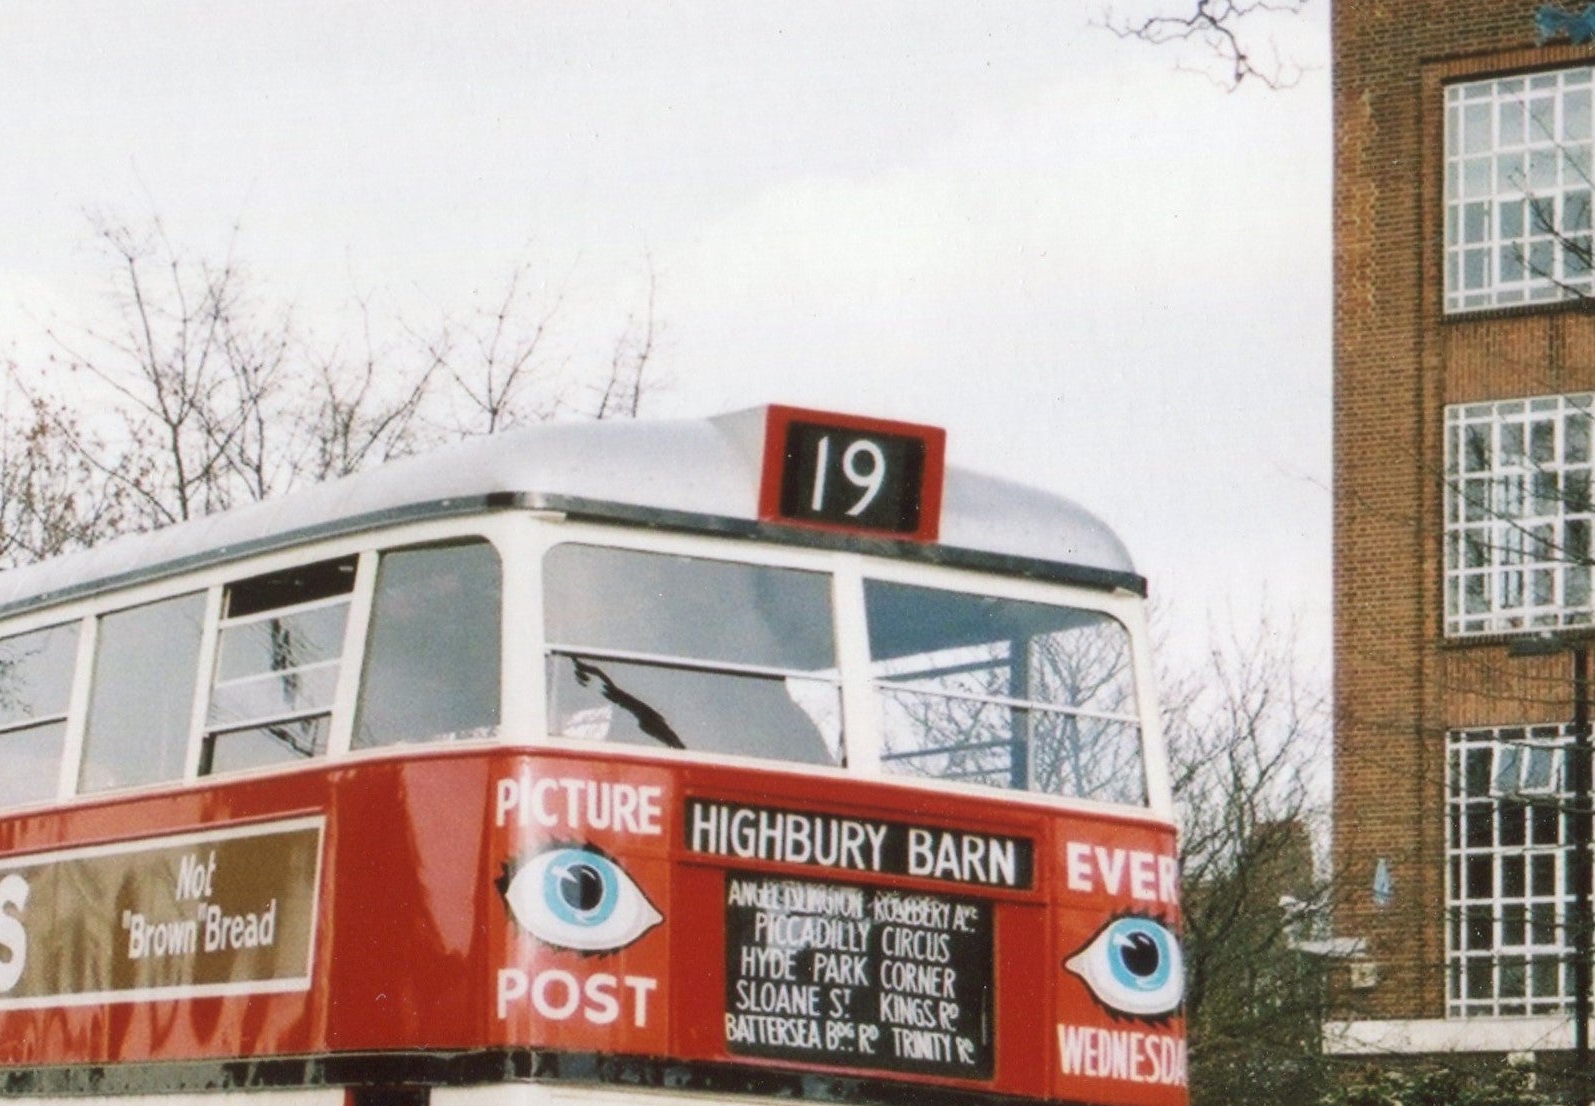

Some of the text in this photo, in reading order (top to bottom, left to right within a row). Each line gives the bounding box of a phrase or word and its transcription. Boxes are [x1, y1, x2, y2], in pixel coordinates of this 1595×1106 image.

[811, 436, 885, 516] 19
[496, 776, 663, 836] PICTURE
[691, 802, 1017, 887] HIGHBURY BARN
[176, 852, 217, 900] Not
[1066, 841, 1180, 906] EVER
[203, 901, 276, 952] Bread
[755, 912, 951, 964] PICCADILLY CIRCUS
[497, 968, 658, 1028] POST
[741, 945, 957, 1000] HYDE PARK CORNER
[736, 980, 821, 1018] SLOANE
[879, 993, 936, 1028] KINGS
[725, 1012, 822, 1050] BATTERSEA
[891, 1027, 953, 1063] TRINITY
[1057, 1023, 1188, 1087] WEDNESDA
